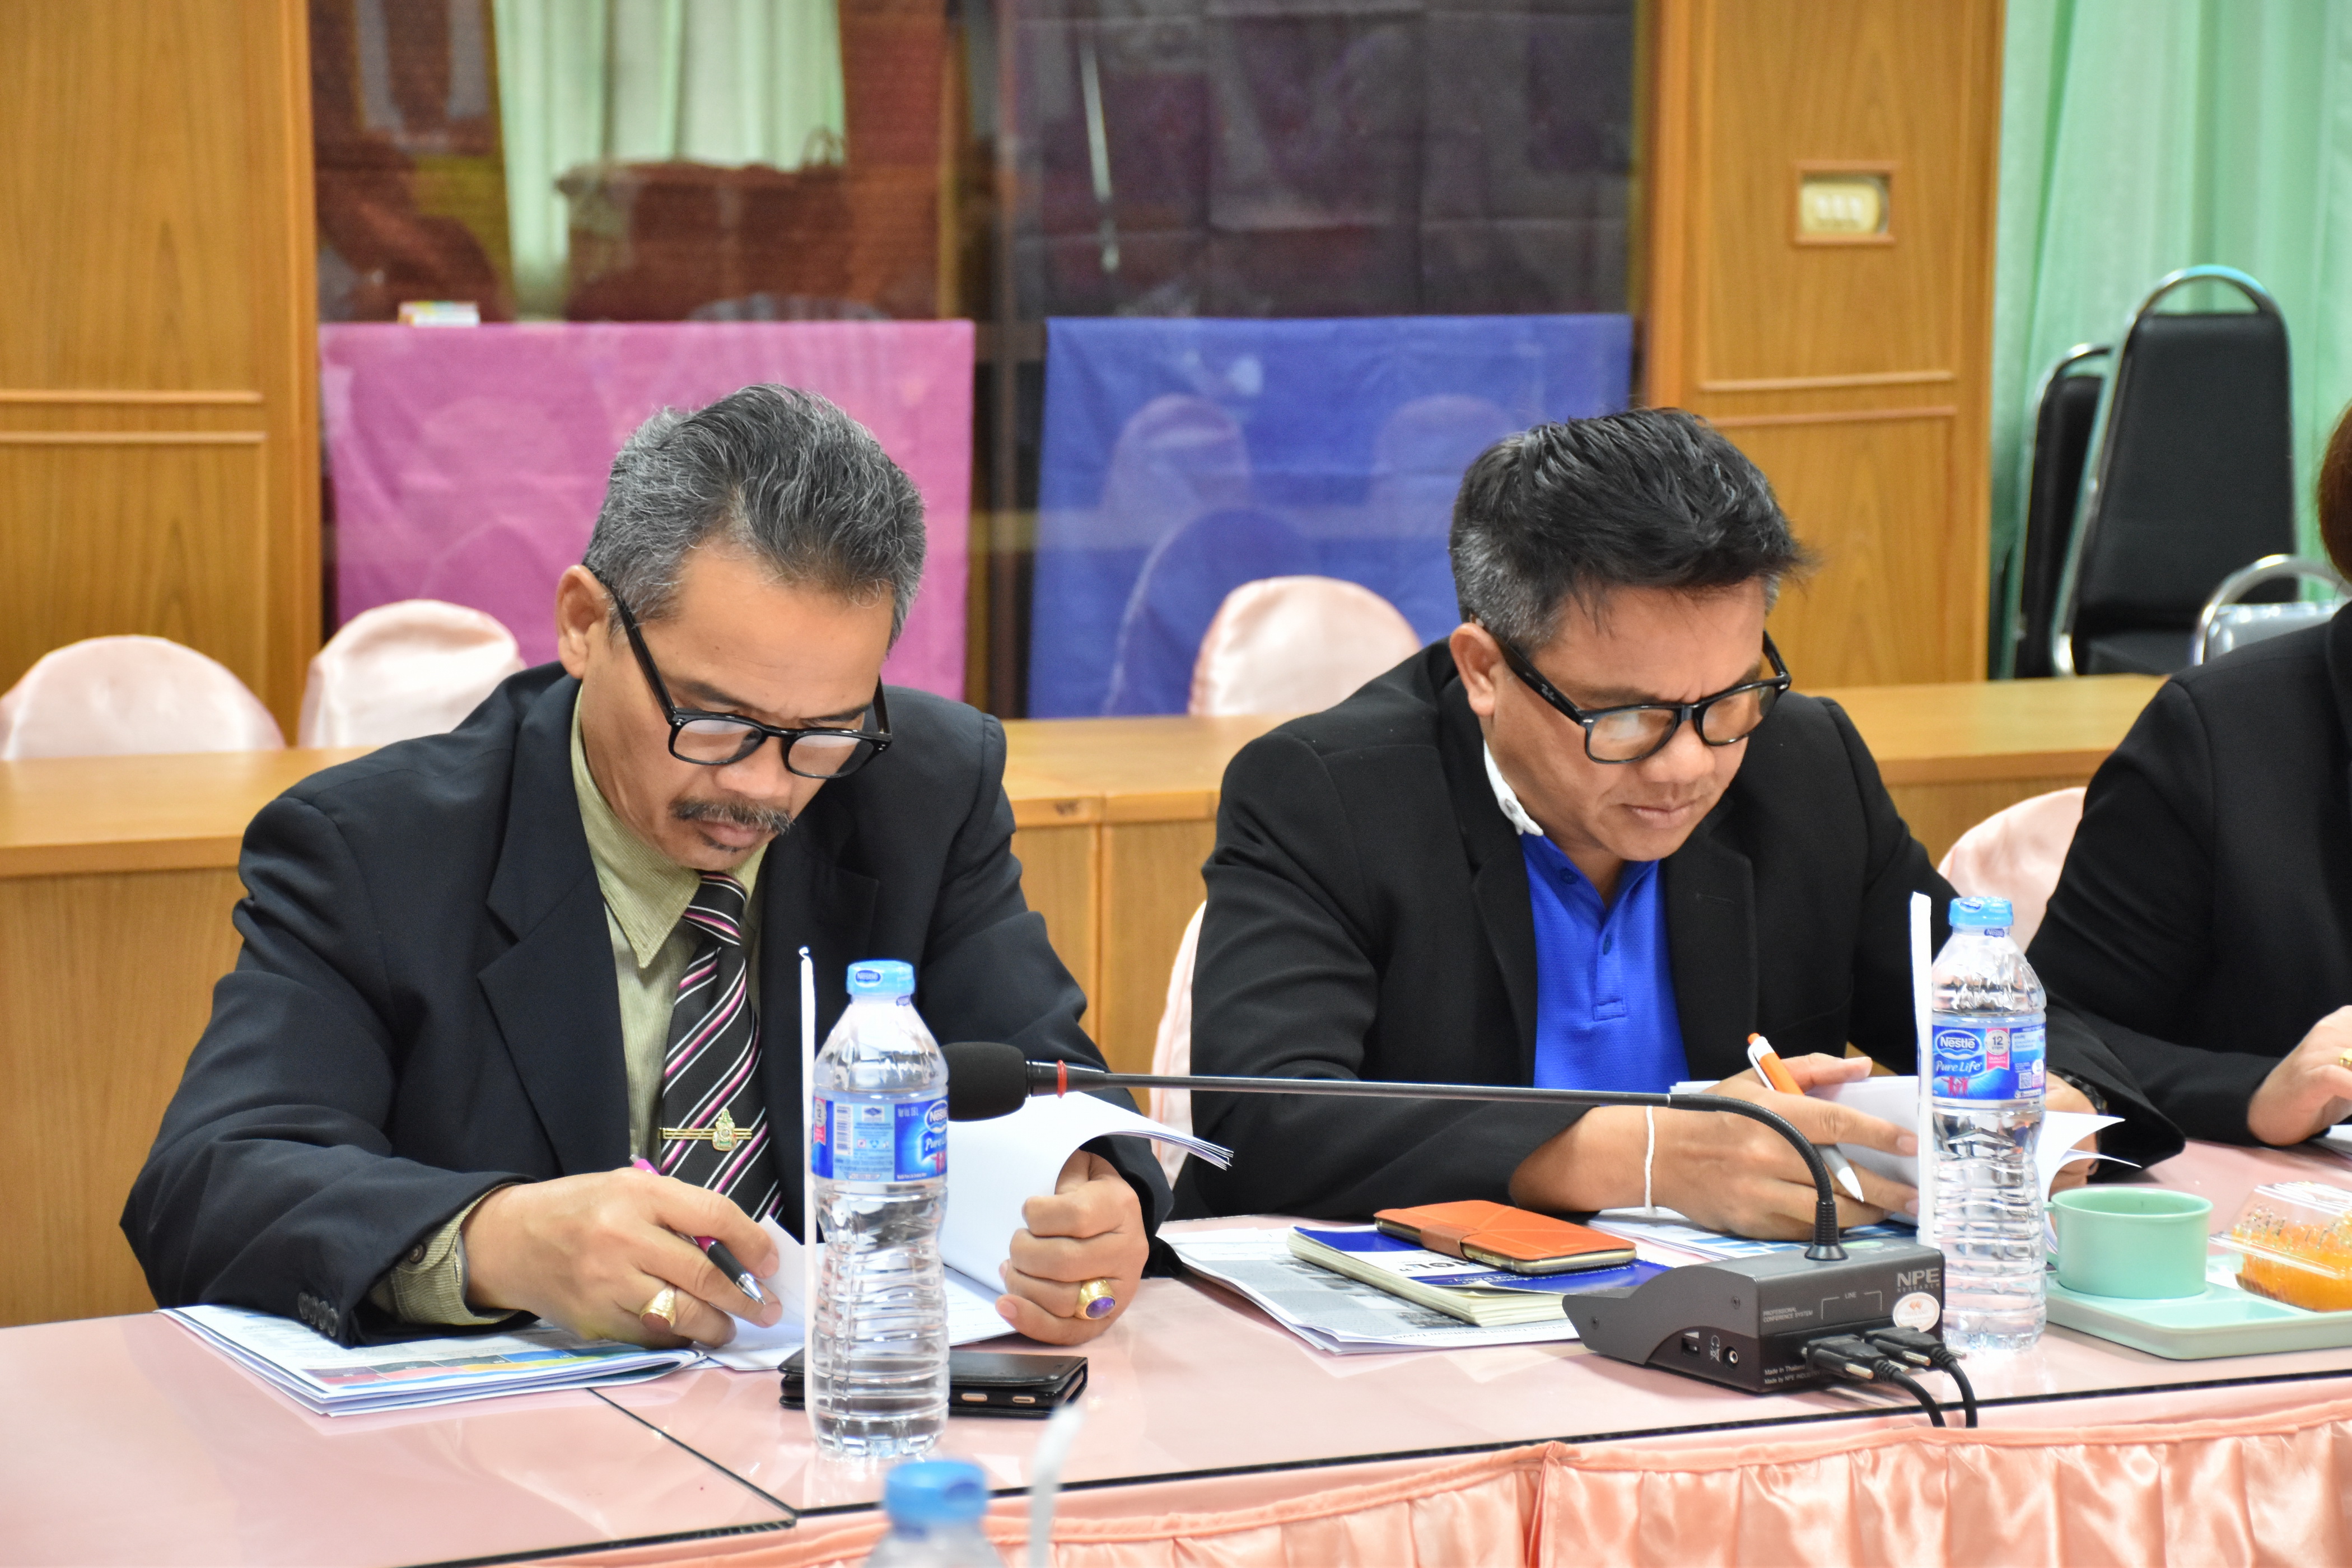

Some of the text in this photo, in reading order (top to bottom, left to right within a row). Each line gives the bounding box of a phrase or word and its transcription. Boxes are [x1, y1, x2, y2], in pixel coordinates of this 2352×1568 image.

[1992, 1035, 2003, 1046] 12
[1936, 1060, 1981, 1073] Pure Life
[1897, 1267, 1940, 1287] NPE
[1897, 1282, 1940, 1293] RESEARCH
[1794, 1310, 1813, 1318] SYSTEM
